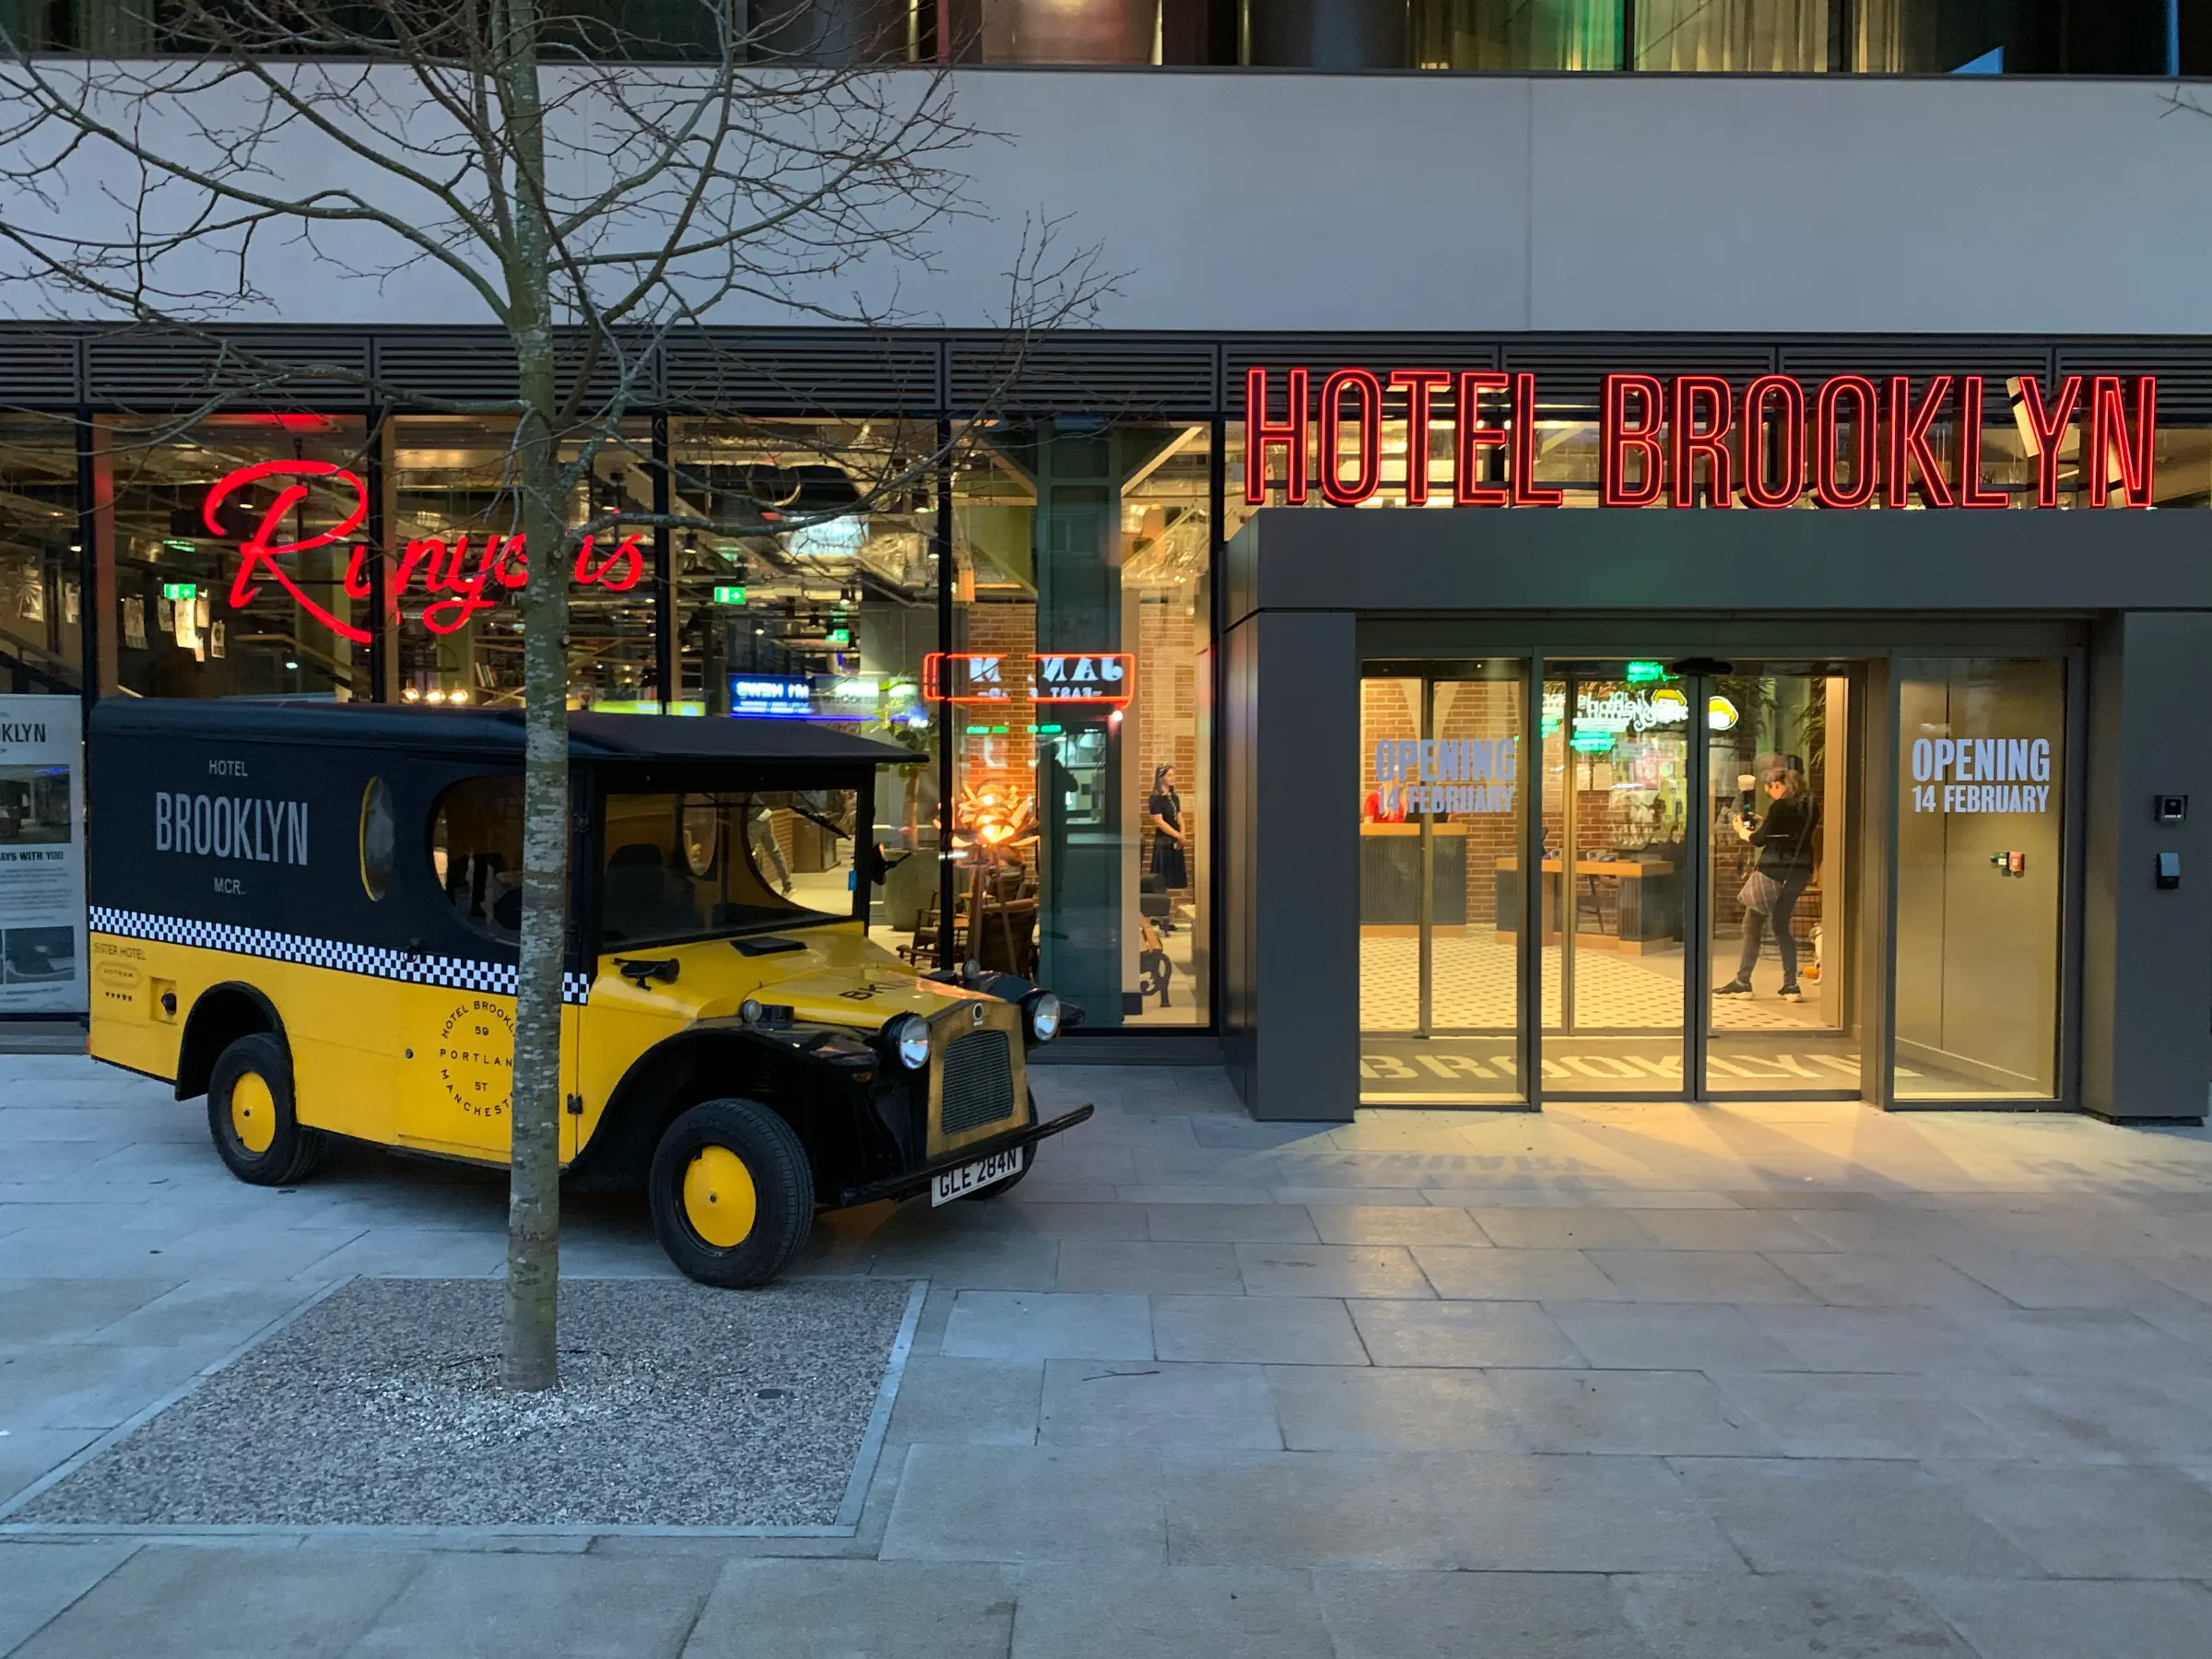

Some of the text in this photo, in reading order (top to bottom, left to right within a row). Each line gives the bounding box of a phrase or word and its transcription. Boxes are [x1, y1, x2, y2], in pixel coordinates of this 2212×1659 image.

[1245, 369, 2158, 508] HOTEL BROOKLYN
[0, 724, 46, 742] KLYN
[208, 759, 249, 777] HOTEL
[1375, 739, 1515, 782] OPENING
[1912, 738, 2050, 782] OPENING
[1378, 786, 1516, 814] 14 FEBRUARY
[1912, 785, 2050, 813] 14 FEBRUARY
[156, 792, 308, 865] BROOKLYN
[19, 852, 43, 861] WITH
[214, 877, 246, 896] MCR.
[120, 947, 147, 960] HOTEL
[441, 1000, 516, 1039] HOTEL BROOKL
[475, 1026, 489, 1036] 59
[440, 1049, 513, 1067] PORTLAN
[441, 1069, 514, 1117] MANCHEST
[475, 1081, 488, 1091] ST
[940, 1149, 1017, 1197] GLE 284N
